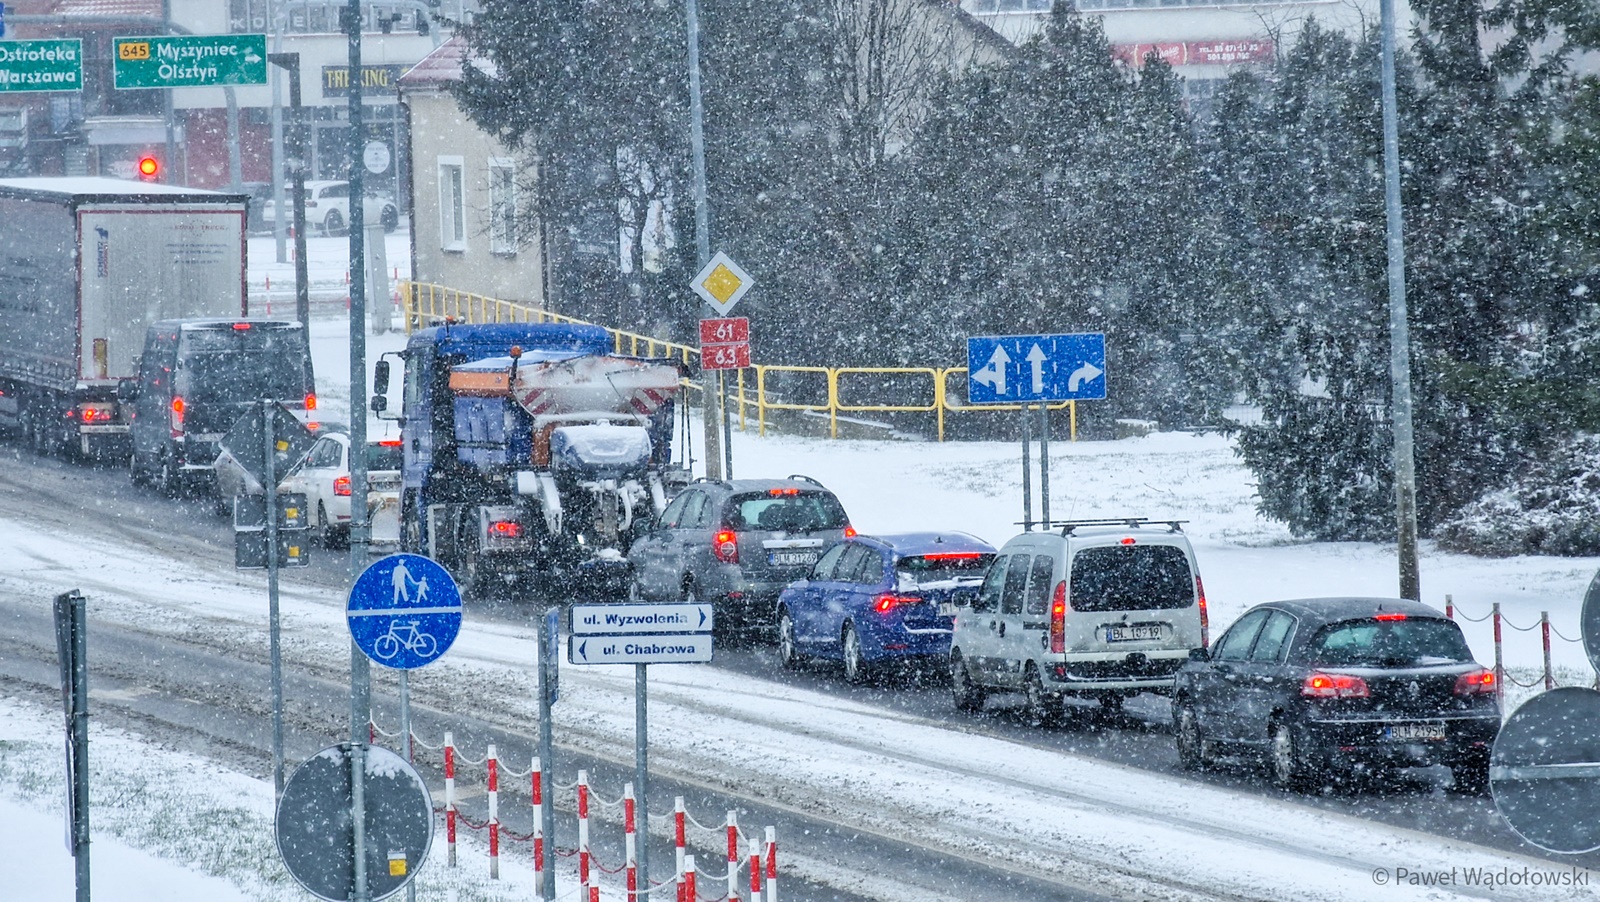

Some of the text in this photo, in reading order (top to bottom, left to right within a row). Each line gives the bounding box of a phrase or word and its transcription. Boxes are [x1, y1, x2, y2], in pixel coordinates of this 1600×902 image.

[122, 45, 147, 57] 645
[157, 42, 238, 62] Myszyniec
[158, 63, 217, 82] Olsztyn
[716, 323, 733, 339] 61
[715, 348, 736, 365] 63
[583, 613, 688, 627] ul. Wyzwolenia
[1113, 628, 1127, 639] BL
[603, 643, 696, 655] ul. Chabrowa
